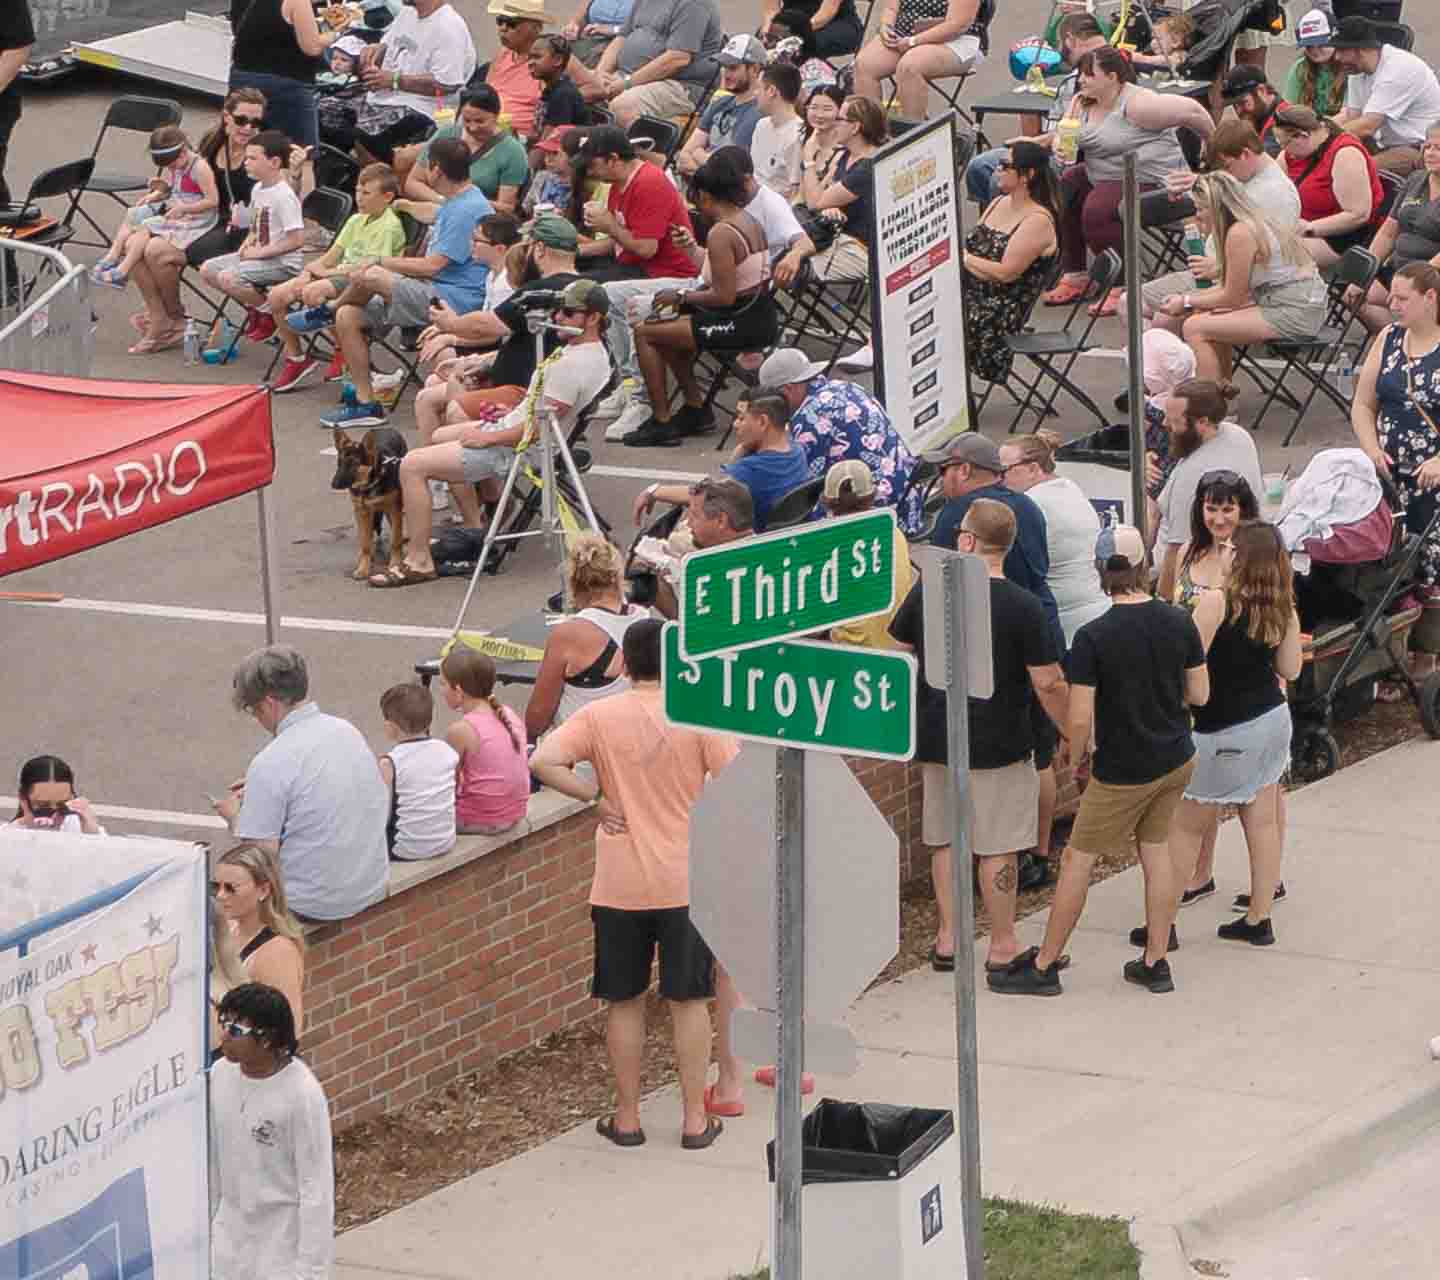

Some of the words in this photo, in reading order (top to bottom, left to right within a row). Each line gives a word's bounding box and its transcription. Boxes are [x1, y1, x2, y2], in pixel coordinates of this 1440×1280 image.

[695, 575, 711, 616] E
[725, 546, 840, 626] Third
[851, 537, 882, 579] St
[717, 652, 836, 737] Troy
[853, 669, 897, 713] St
[45, 949, 73, 983] OAK
[45, 932, 181, 1072] FEST
[110, 1051, 187, 1131] EAGLE
